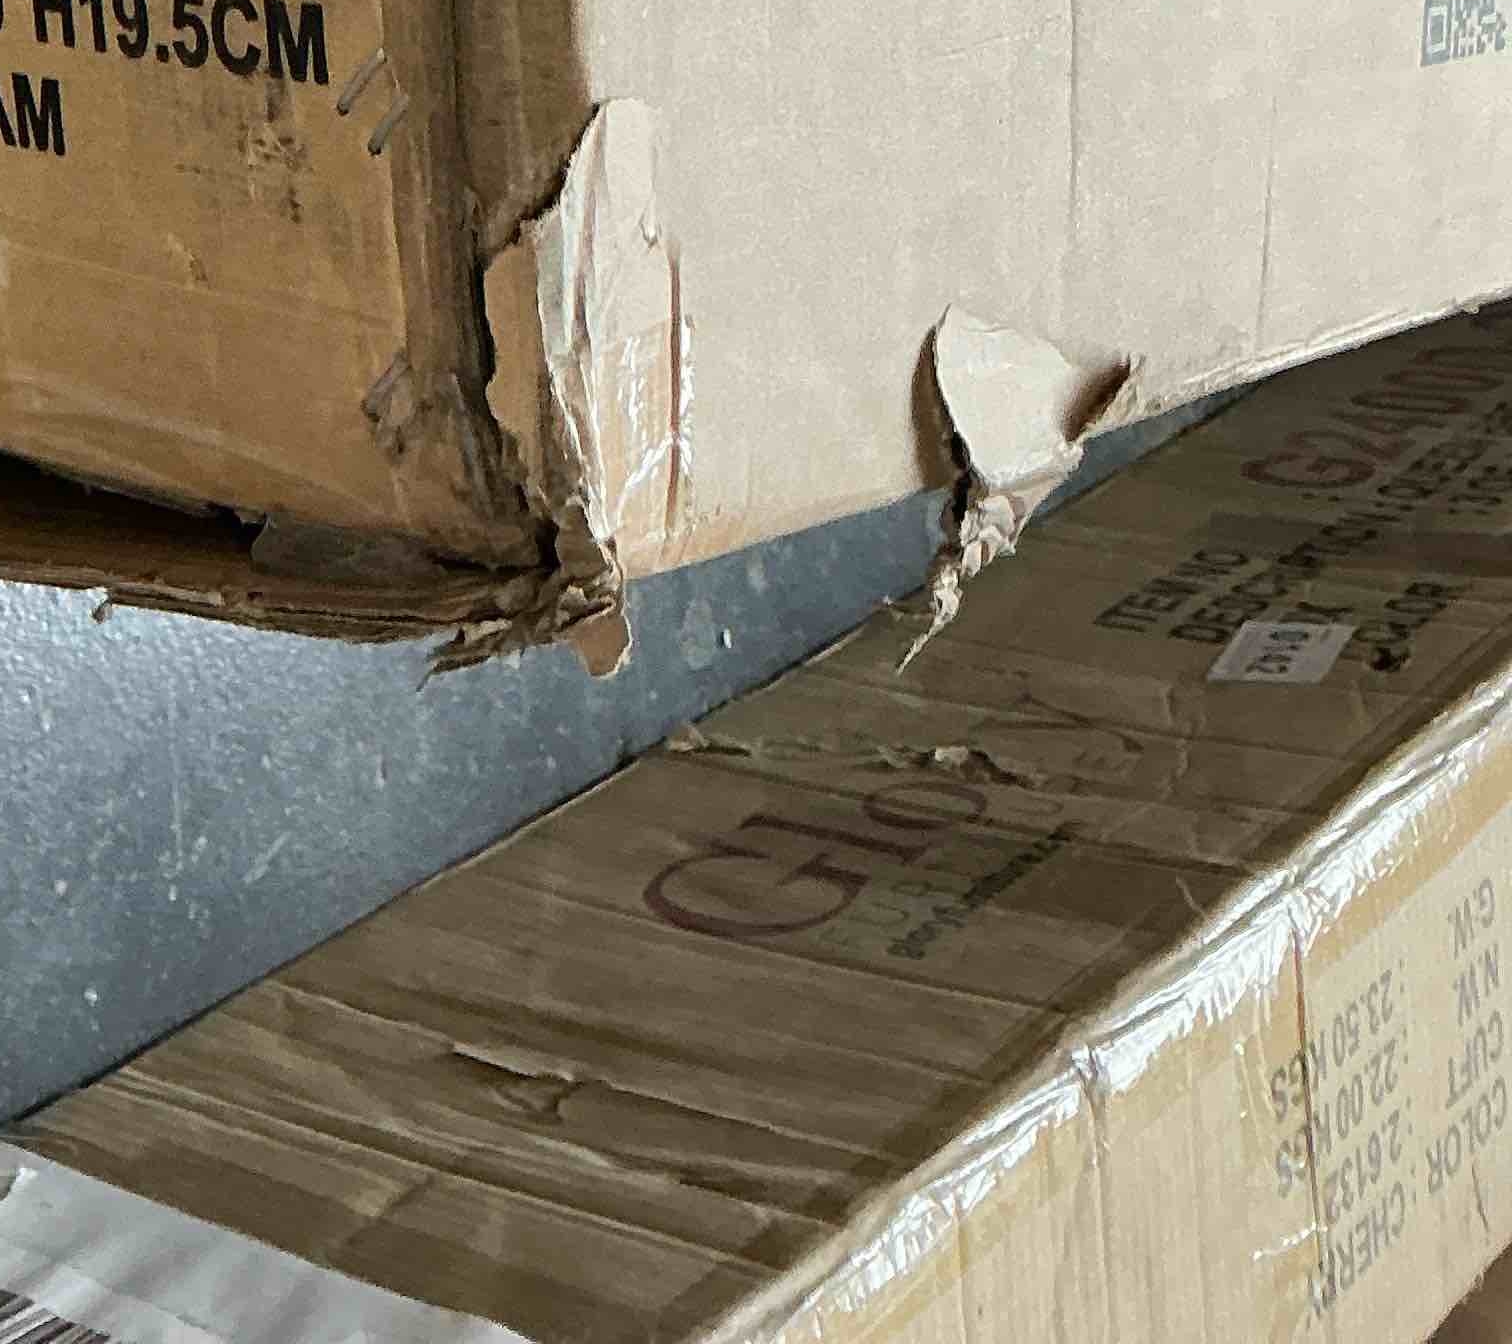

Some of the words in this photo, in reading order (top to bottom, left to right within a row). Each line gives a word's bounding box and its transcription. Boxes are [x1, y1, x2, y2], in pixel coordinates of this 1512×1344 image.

[1332, 967, 1394, 1069] 23.50
[1445, 1012, 1504, 1110] CUFT
[1338, 1037, 1399, 1140] 22.00
[1427, 1076, 1509, 1196] COLOR
